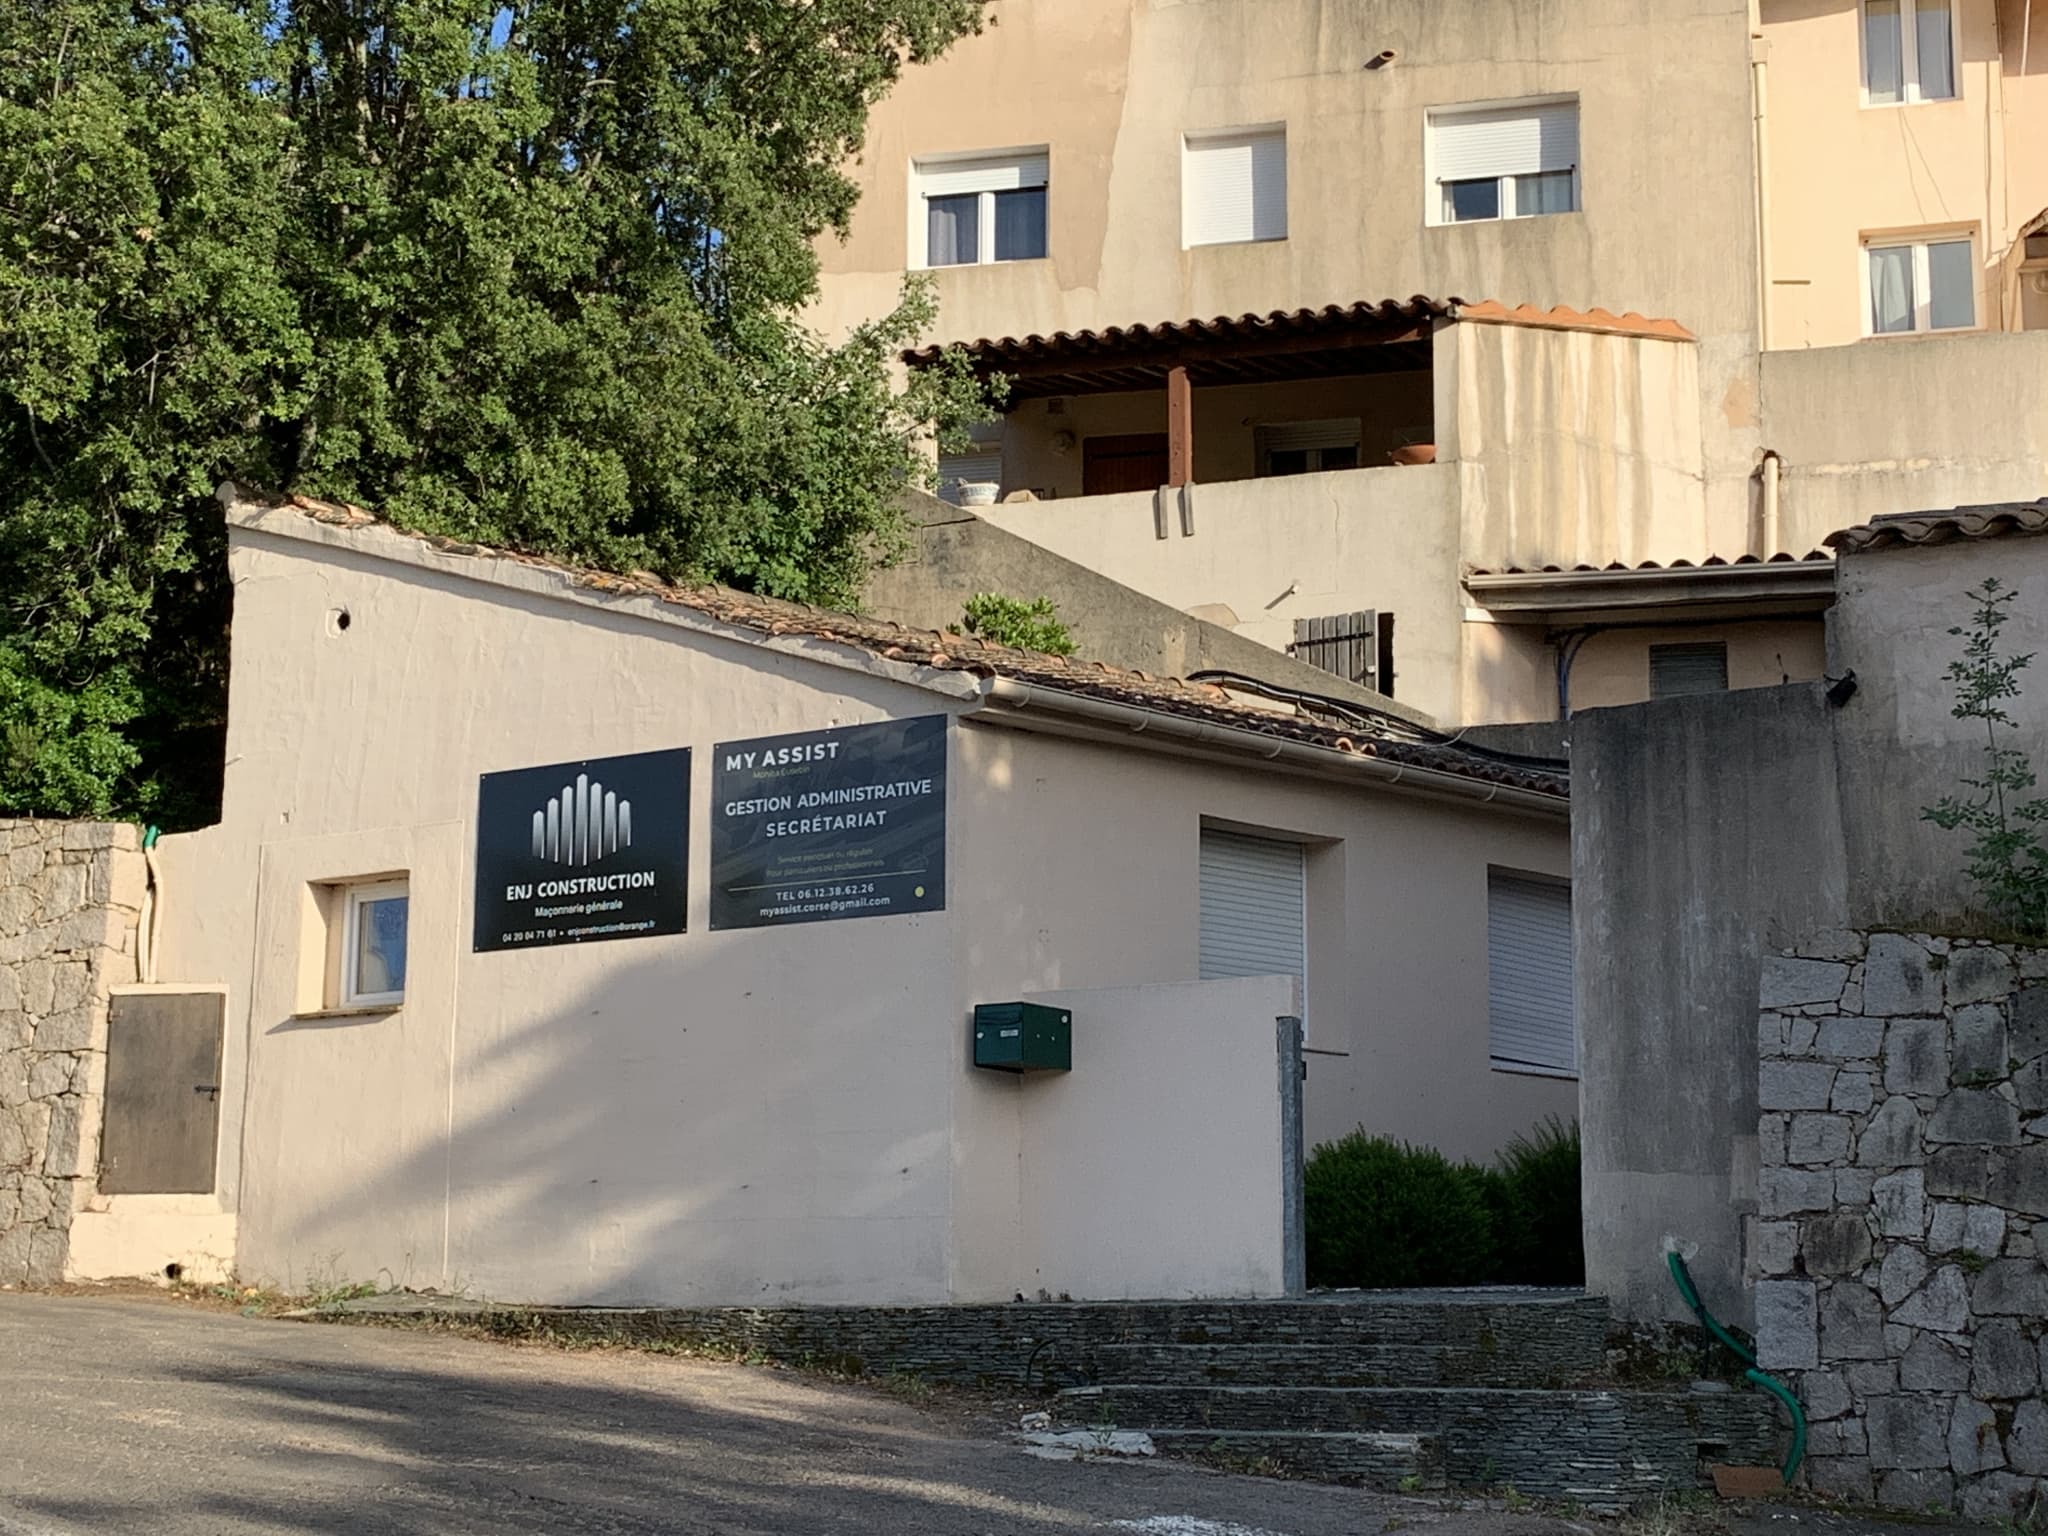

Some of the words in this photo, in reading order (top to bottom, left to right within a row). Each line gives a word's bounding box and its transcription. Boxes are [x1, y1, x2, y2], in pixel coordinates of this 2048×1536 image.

[726, 752, 757, 771] MY
[762, 742, 839, 767] ASSIST
[725, 796, 791, 816] GESTION
[797, 779, 932, 808] ADMINISTRATIVE
[766, 811, 887, 837] SECRÉTARIAT
[506, 884, 532, 901] ENJ
[537, 871, 655, 897] CONSTRUCTION
[776, 891, 795, 902] TEL
[759, 896, 890, 918] myassist.corse@gmail.com
